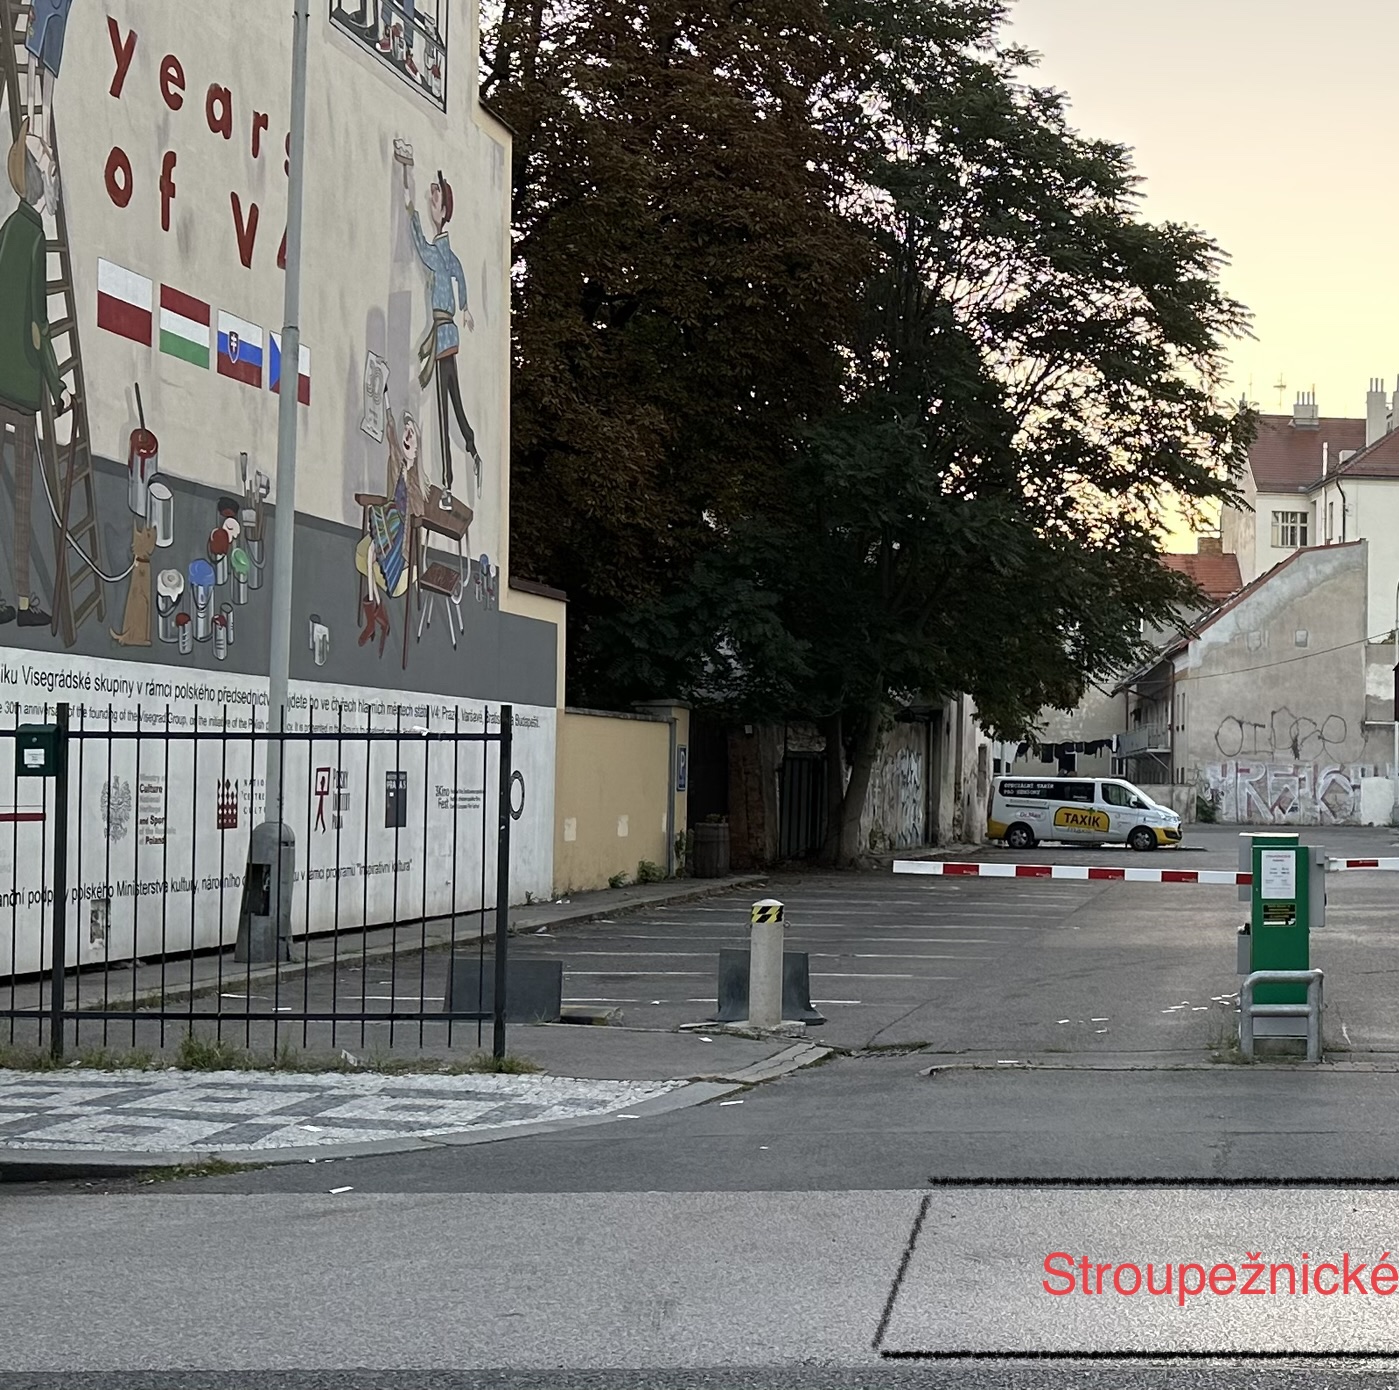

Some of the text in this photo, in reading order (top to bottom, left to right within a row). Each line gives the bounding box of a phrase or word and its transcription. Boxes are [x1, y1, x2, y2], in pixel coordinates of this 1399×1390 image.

[106, 14, 291, 178] year
[104, 146, 177, 232] of
[22, 665, 91, 692] Visegrádské
[94, 673, 134, 698] skupiny
[137, 681, 143, 694] v
[145, 679, 172, 698] rámci
[174, 682, 215, 703] polského
[217, 686, 270, 706] předsednictv
[1064, 812, 1101, 827] TAXIK
[28, 886, 69, 909] podpy
[72, 882, 114, 905] polského
